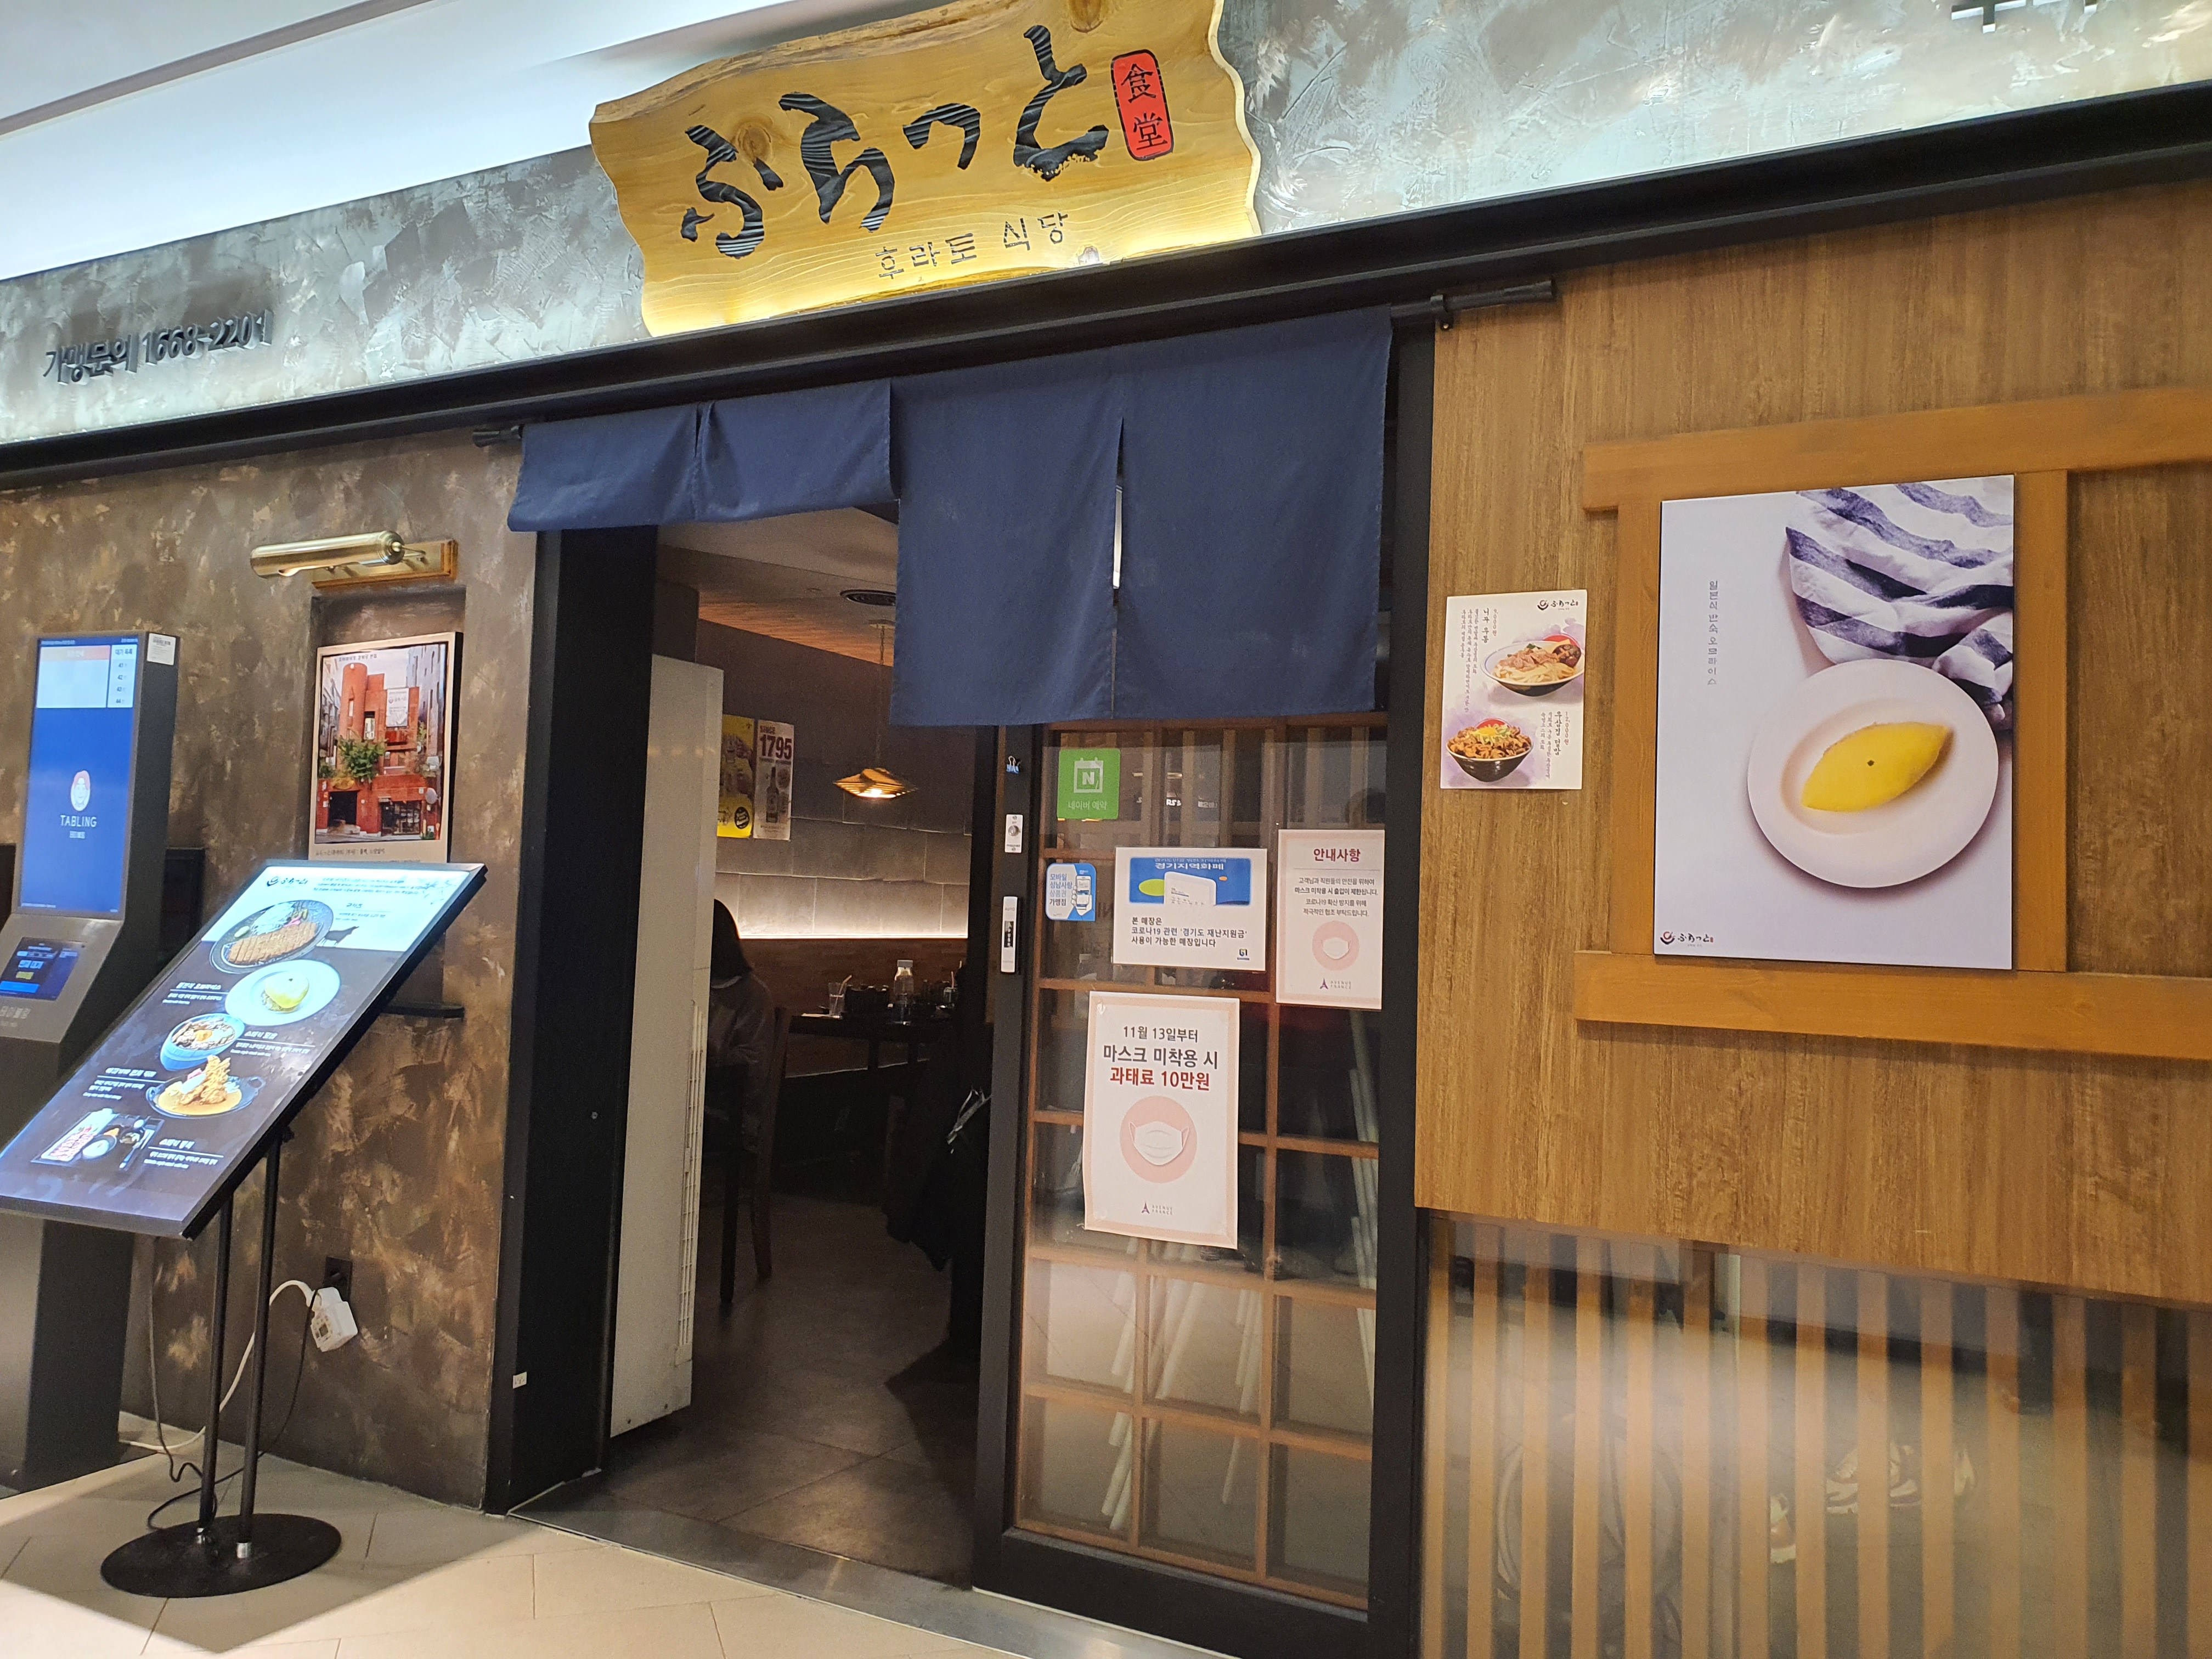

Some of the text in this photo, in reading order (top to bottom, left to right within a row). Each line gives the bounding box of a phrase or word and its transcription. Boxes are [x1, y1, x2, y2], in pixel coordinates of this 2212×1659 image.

[1121, 64, 1167, 150] 食堂
[876, 211, 1068, 279] 후라토 식당
[43, 310, 273, 385] 가맹문의 1668-2201
[1482, 628, 1489, 644] 우동
[1707, 636, 1718, 685] 오므라이스
[760, 735, 792, 759] 1795
[1082, 771, 1094, 785] N
[1068, 800, 1107, 810] 네이버 예약
[60, 815, 97, 827] TABLING
[1313, 848, 1361, 862] 안내사항
[1050, 881, 1073, 889] 성남사랑
[1132, 917, 1162, 926] 본 매장은
[1131, 927, 1161, 935] 코로나19
[1164, 928, 1177, 936] 관련
[1131, 936, 1216, 947] 사용이 가능한 매장입니다
[1124, 1026, 1198, 1042] 11월 13일부터
[1104, 1045, 1217, 1069] 마스크 미착용 시
[1110, 1067, 1210, 1091] 과태료 10만원
